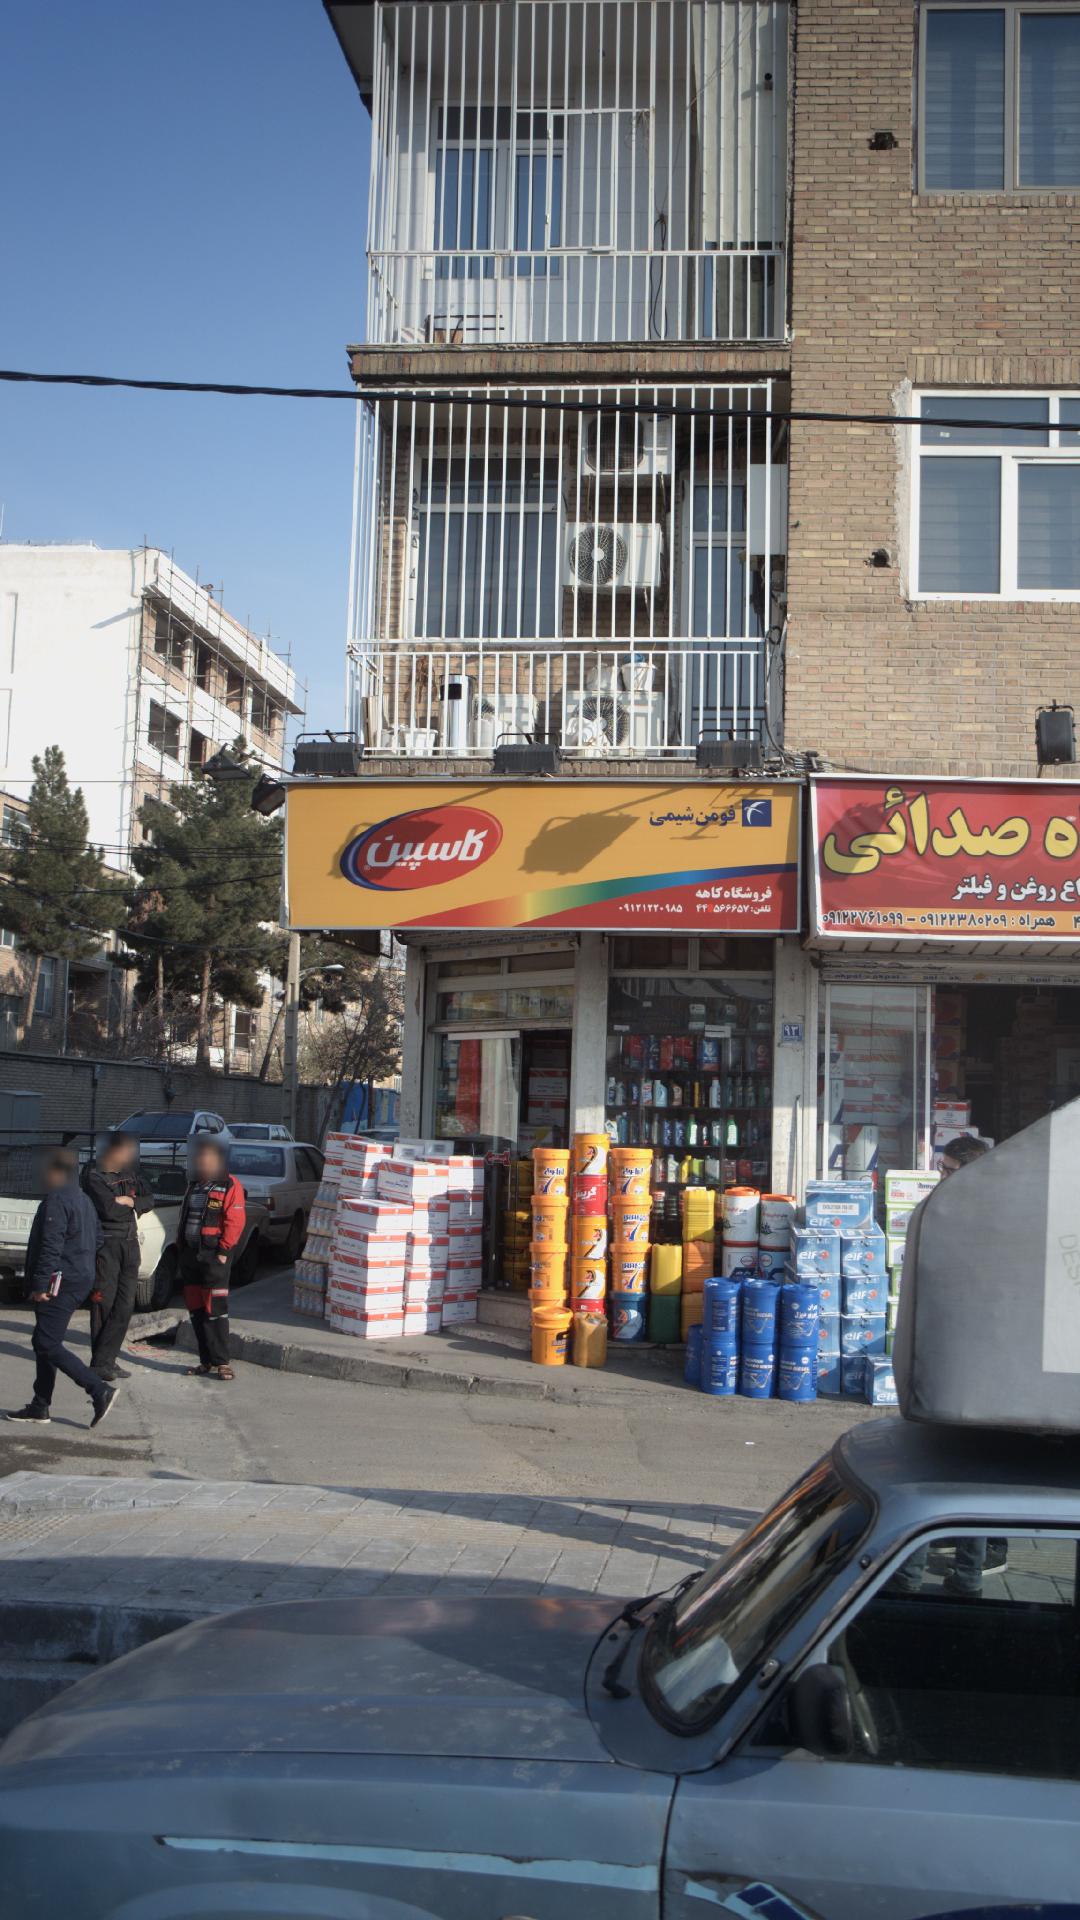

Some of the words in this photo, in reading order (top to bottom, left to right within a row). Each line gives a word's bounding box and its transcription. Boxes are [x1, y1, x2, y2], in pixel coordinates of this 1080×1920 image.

[649, 806, 694, 826] شیمی
[696, 805, 735, 826] فومن
[366, 828, 489, 871] کاسپین
[723, 886, 772, 902] فروشگاه
[952, 874, 993, 900] فیلتر
[996, 883, 1007, 901] و
[1010, 876, 1057, 902] روغن
[822, 910, 904, 926] ۰۹۱۲۲۷۶۱۰۹۹
[919, 912, 1007, 927] ۰۹۱۲۲۳۸۰۲۰۹
[1018, 913, 1056, 930] همراه
[809, 1216, 831, 1227] elf
[799, 1250, 817, 1260] elf
[844, 1251, 863, 1261] elf
[850, 1290, 867, 1300] elf
[844, 1331, 864, 1341] elf
[876, 1392, 897, 1402] elf
